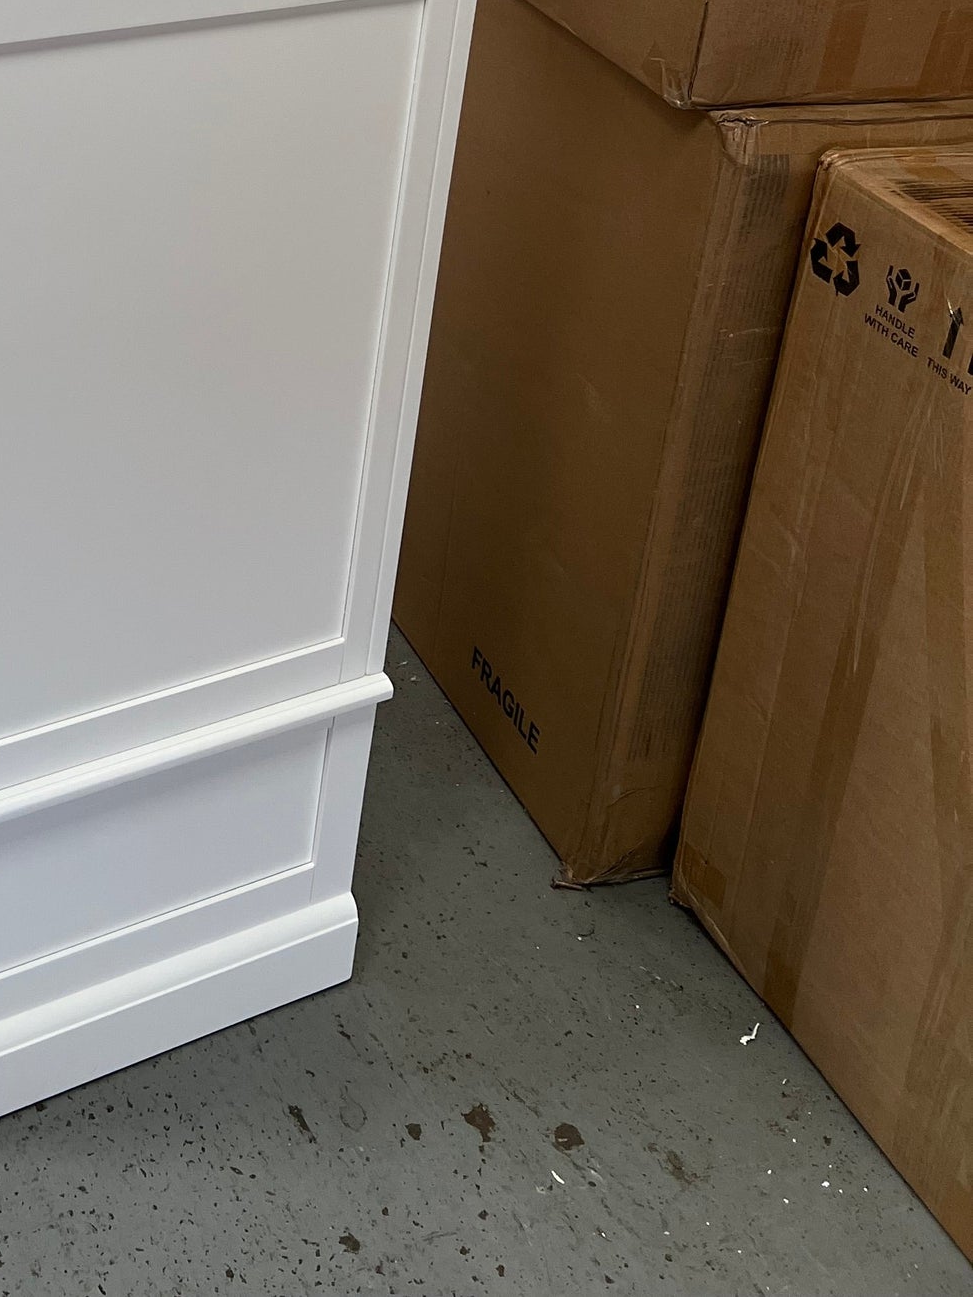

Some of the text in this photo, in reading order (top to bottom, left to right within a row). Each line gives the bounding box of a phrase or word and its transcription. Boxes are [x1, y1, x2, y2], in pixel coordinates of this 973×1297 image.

[864, 313, 919, 358] WITH CARE
[875, 304, 916, 339] HANDLE
[927, 357, 972, 395] THIS WAY
[471, 645, 541, 755] FRAGILE
